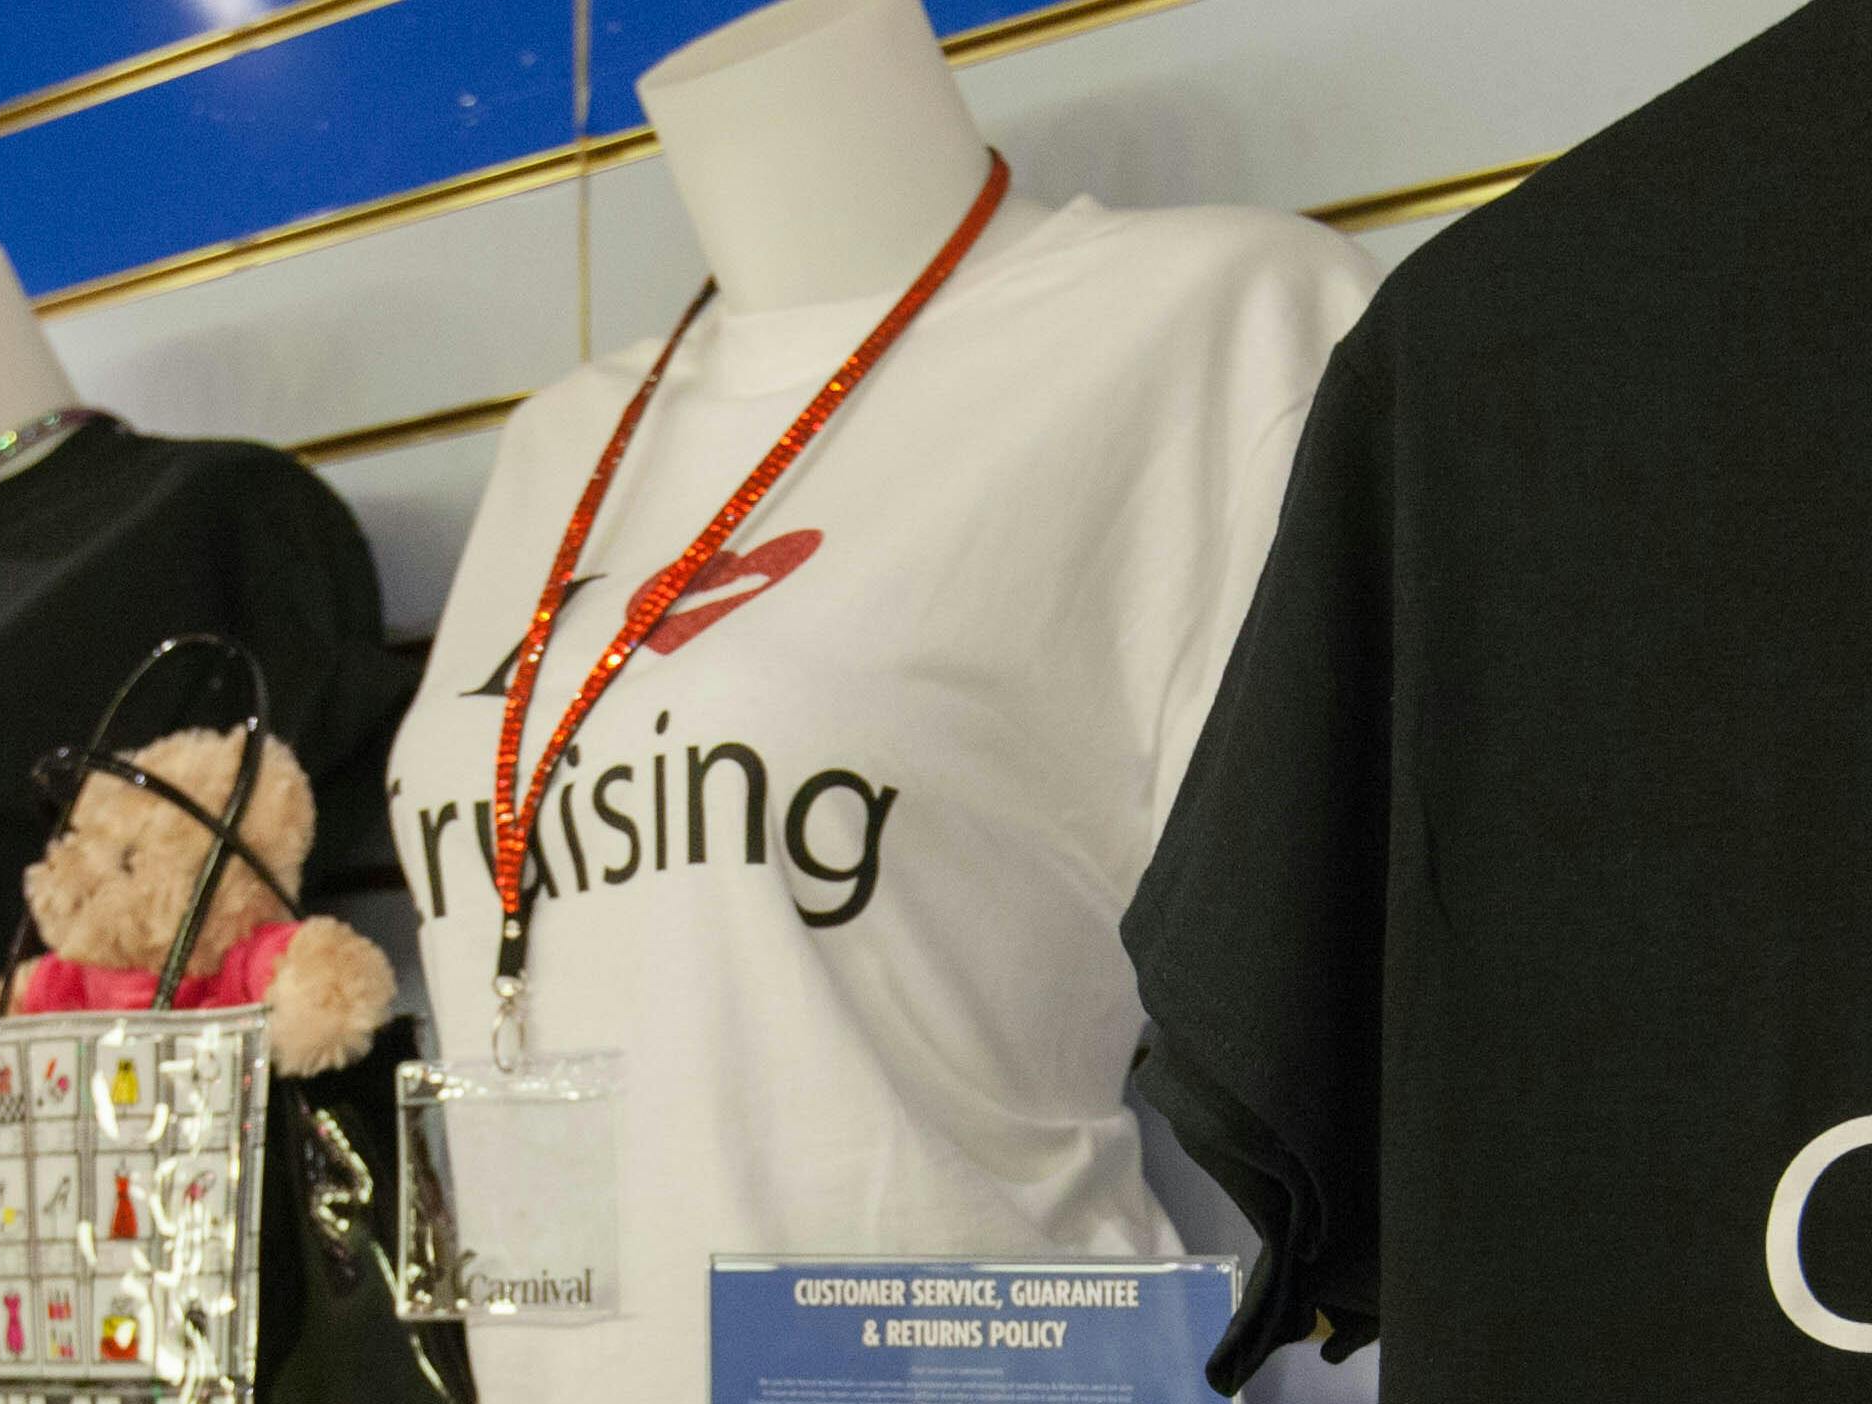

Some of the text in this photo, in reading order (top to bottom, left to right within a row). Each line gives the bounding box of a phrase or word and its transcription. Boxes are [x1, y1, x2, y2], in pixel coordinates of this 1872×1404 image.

[391, 709, 900, 929] ruising
[466, 1267, 595, 1306] Carnival
[794, 1278, 1139, 1310] CUSTOMER SERVICE, GUARANTEE
[862, 1320, 1067, 1348] & RETURNS POLICY
